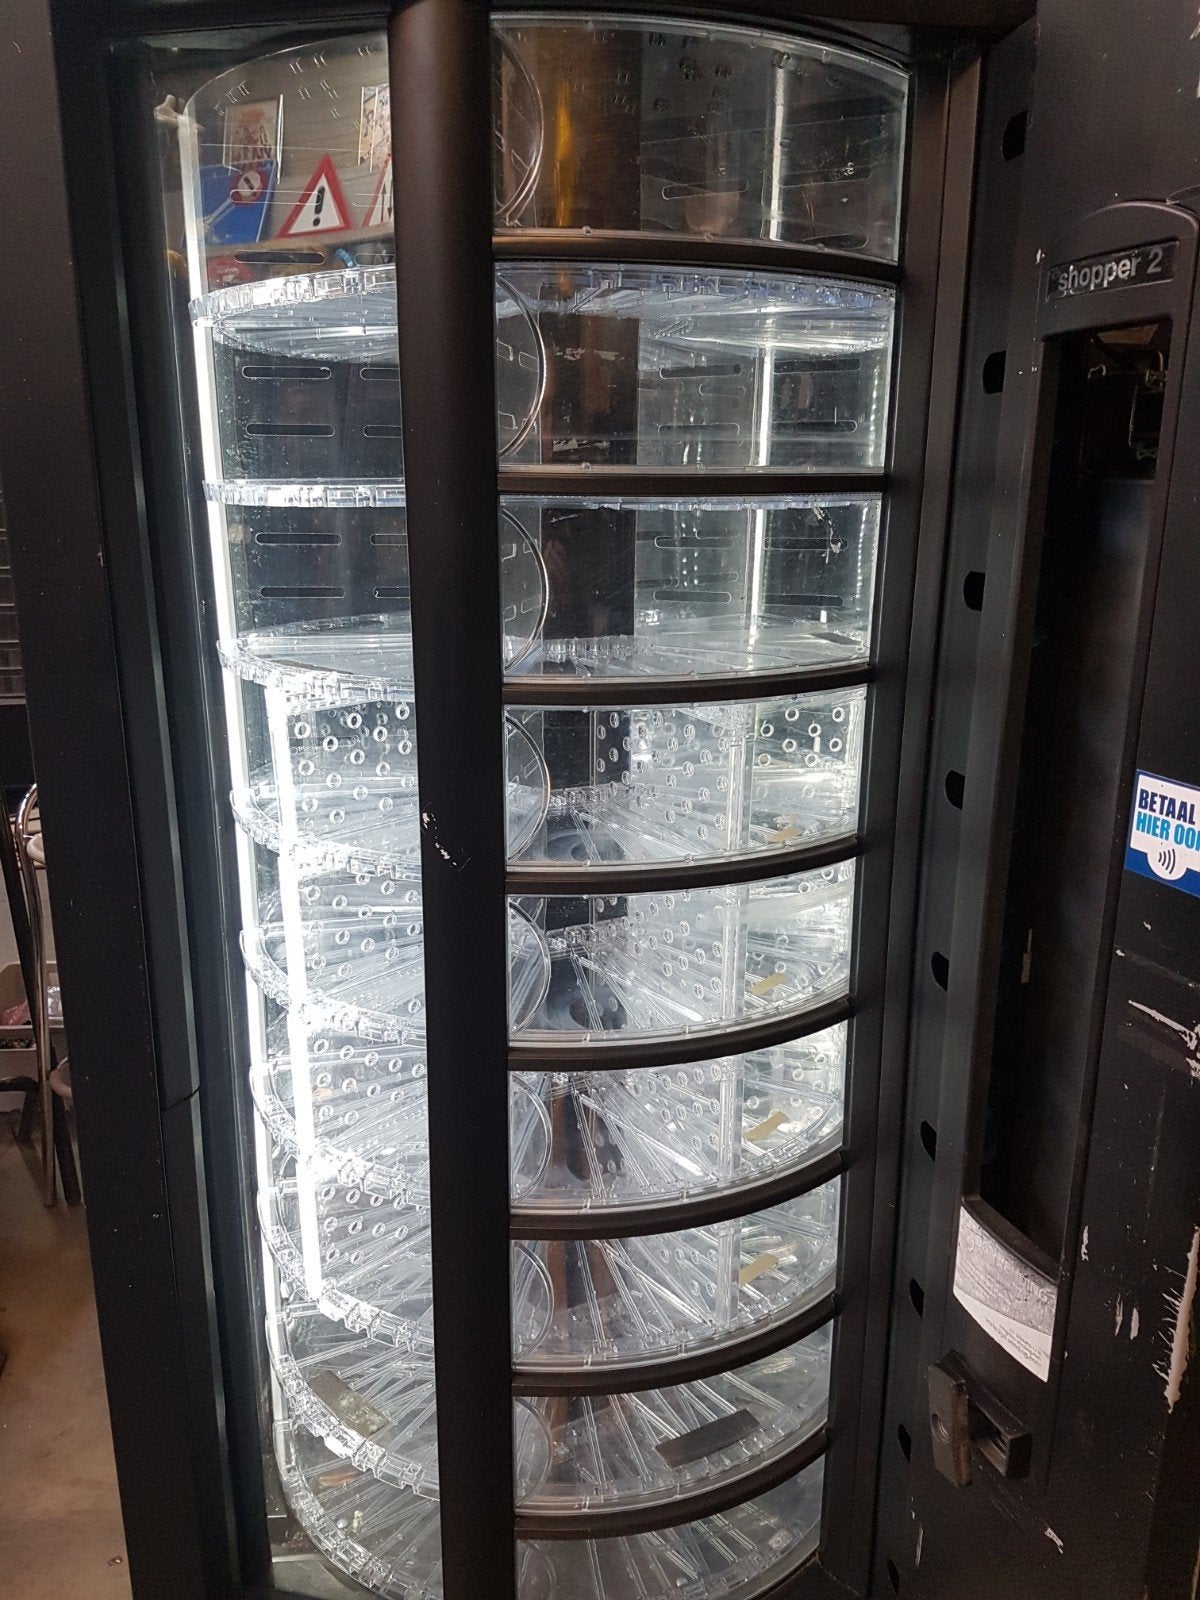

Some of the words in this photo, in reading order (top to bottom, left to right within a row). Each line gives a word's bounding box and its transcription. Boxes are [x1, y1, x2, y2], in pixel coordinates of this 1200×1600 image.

[1058, 255, 1141, 290] shopper
[1147, 248, 1163, 273] 2
[1138, 790, 1195, 824] BETAAL
[1137, 812, 1171, 840] HIER
